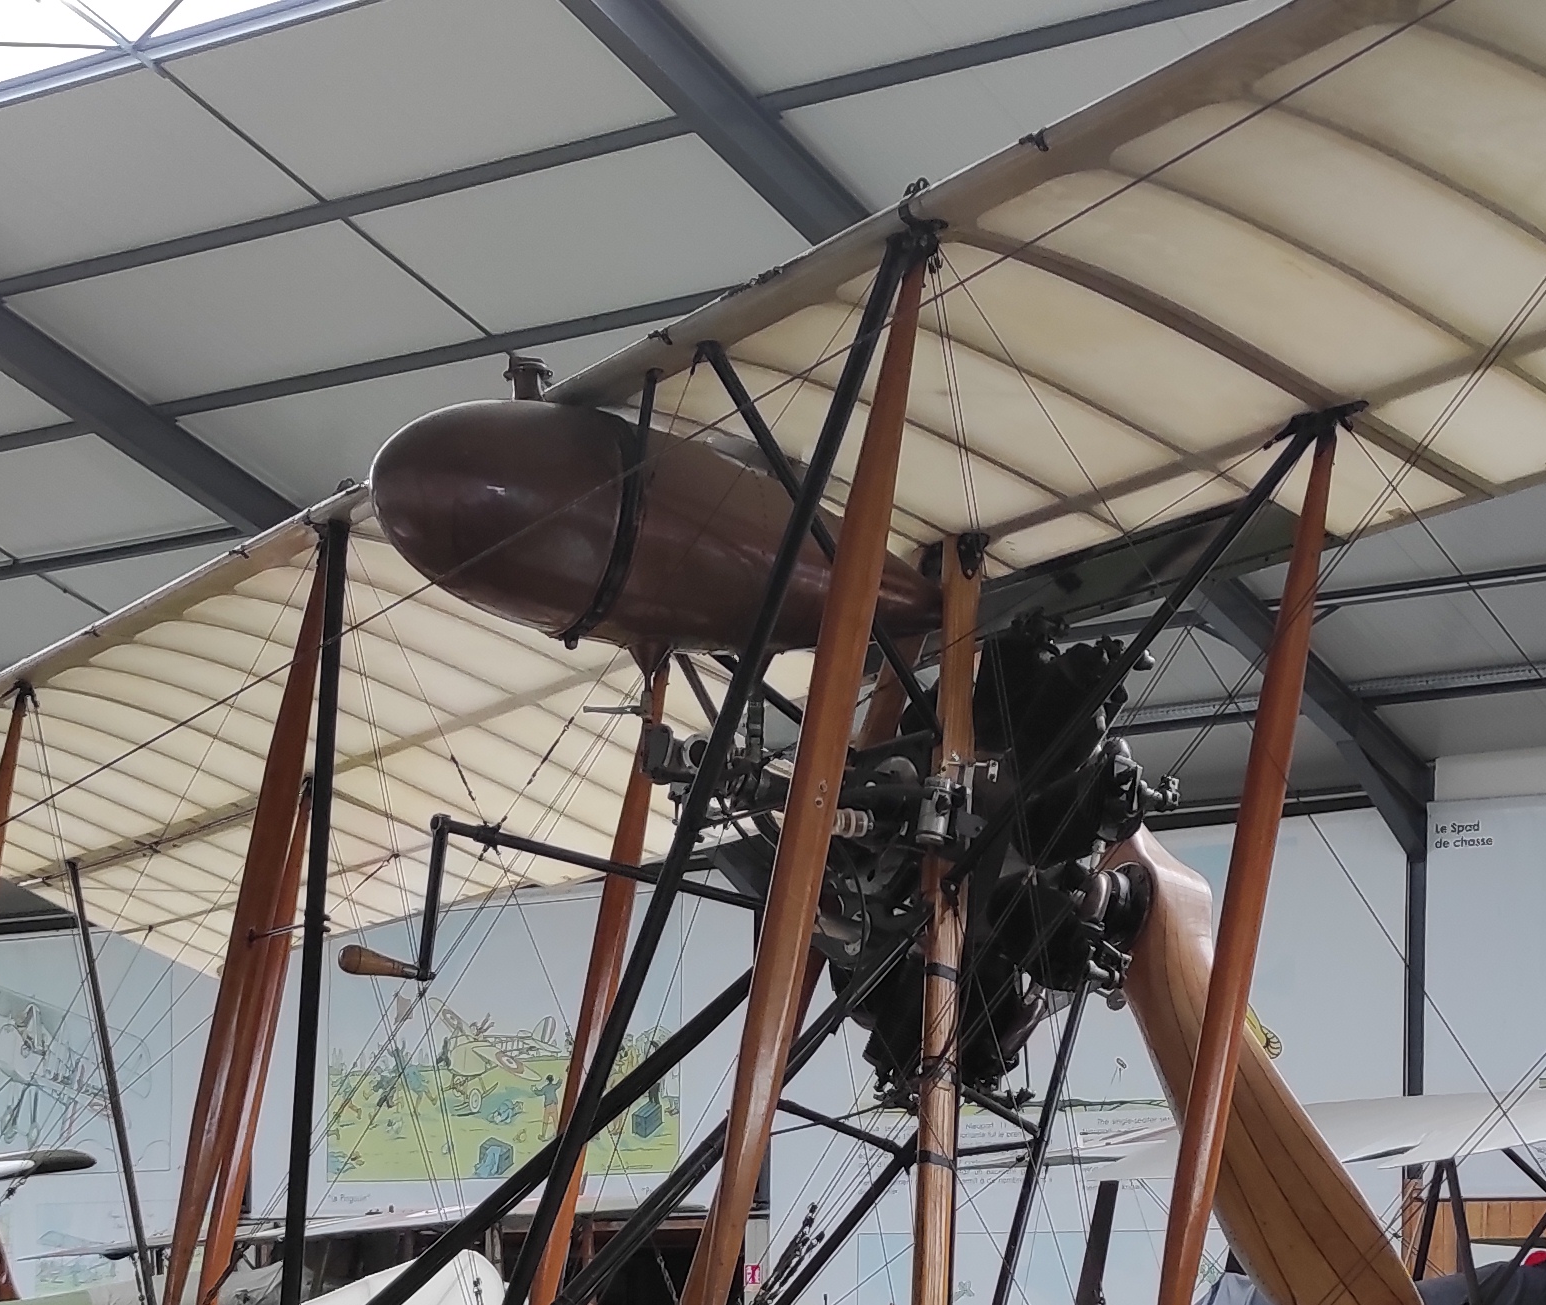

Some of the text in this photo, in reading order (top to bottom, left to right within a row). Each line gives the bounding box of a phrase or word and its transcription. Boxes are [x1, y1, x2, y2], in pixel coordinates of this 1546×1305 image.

[1450, 820, 1480, 835] Spad
[1434, 836, 1493, 849] de chasse
